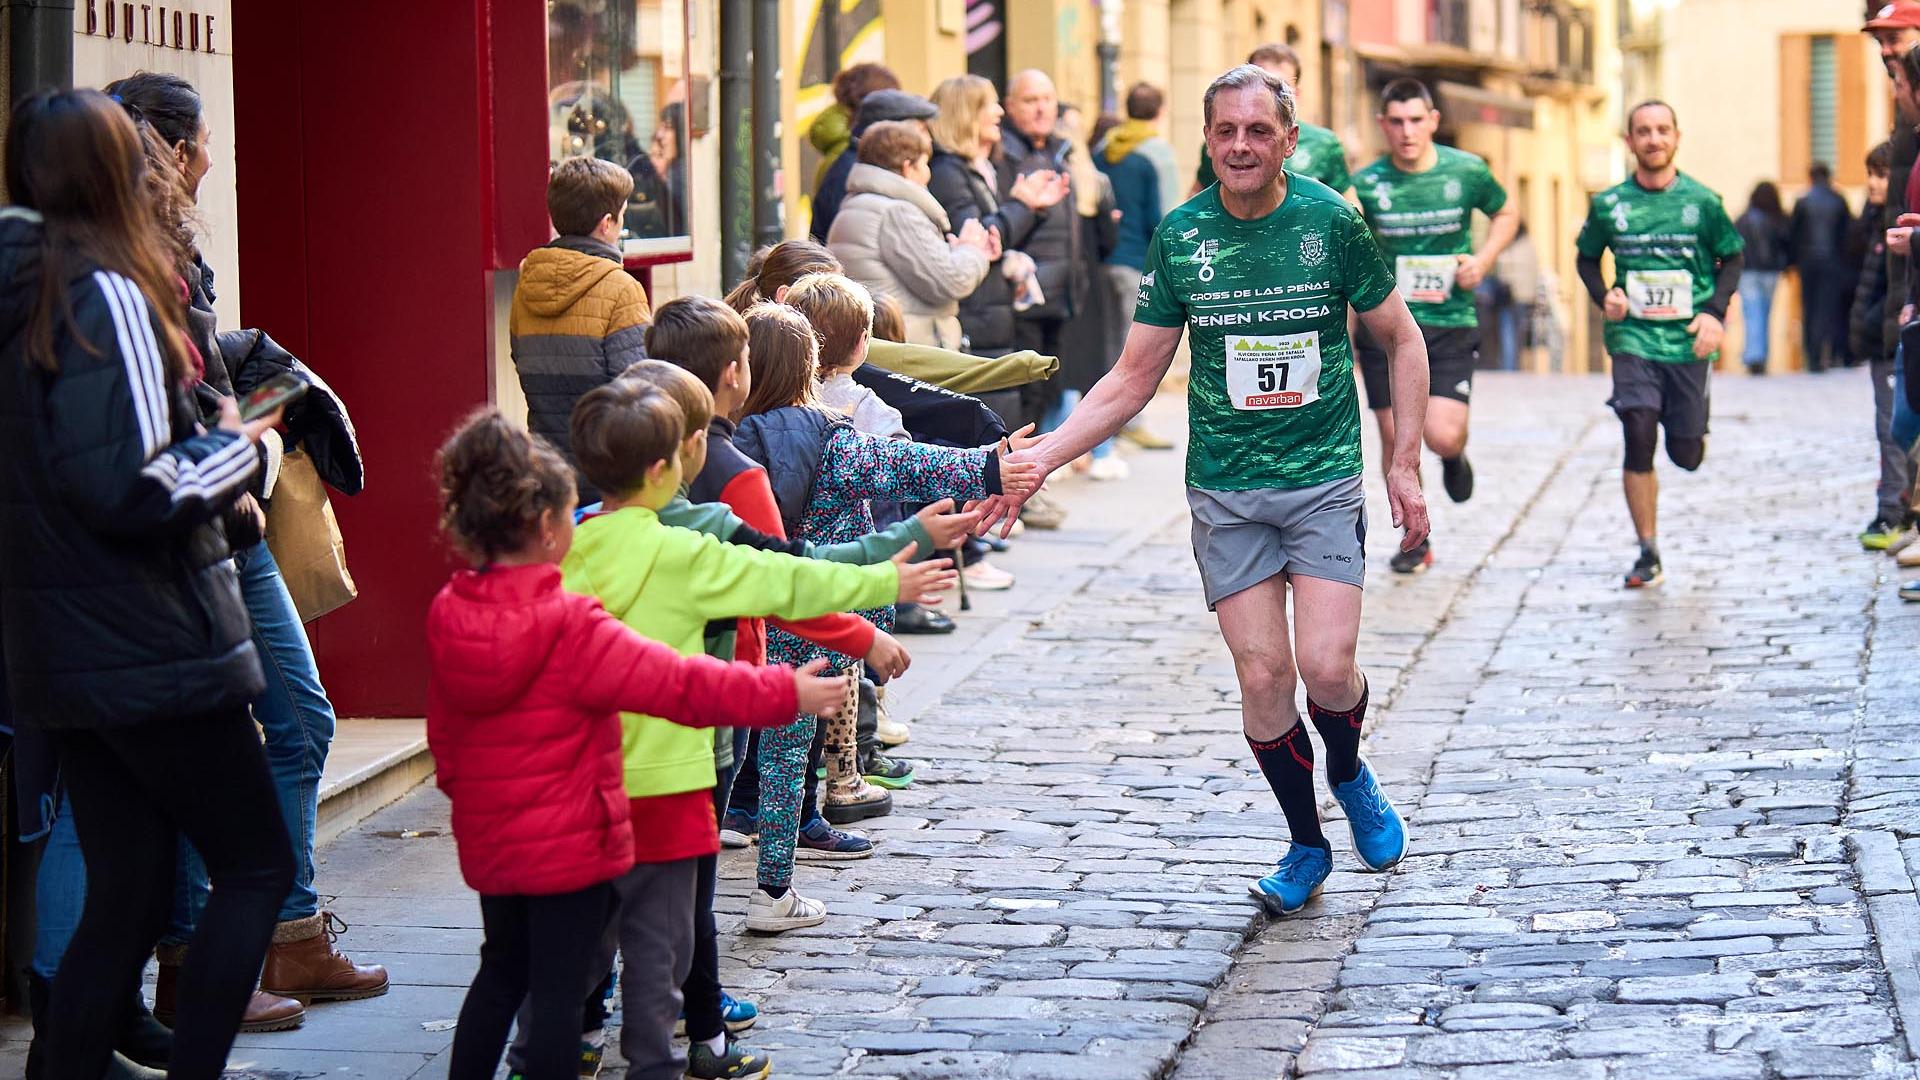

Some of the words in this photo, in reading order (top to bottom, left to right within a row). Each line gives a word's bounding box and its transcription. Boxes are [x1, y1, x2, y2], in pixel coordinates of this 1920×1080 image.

[86, 0, 216, 53] BOUTIQUE
[1190, 291, 1230, 301] CROSS
[1233, 289, 1252, 298] DE
[1254, 286, 1284, 296] LAS
[1287, 280, 1330, 293] PEÑAS
[1644, 287, 1674, 306] 327
[1191, 312, 1251, 327] PEÑEN
[1257, 304, 1331, 322] KROSA
[1257, 362, 1290, 392] 57
[1248, 395, 1301, 405] navarban
